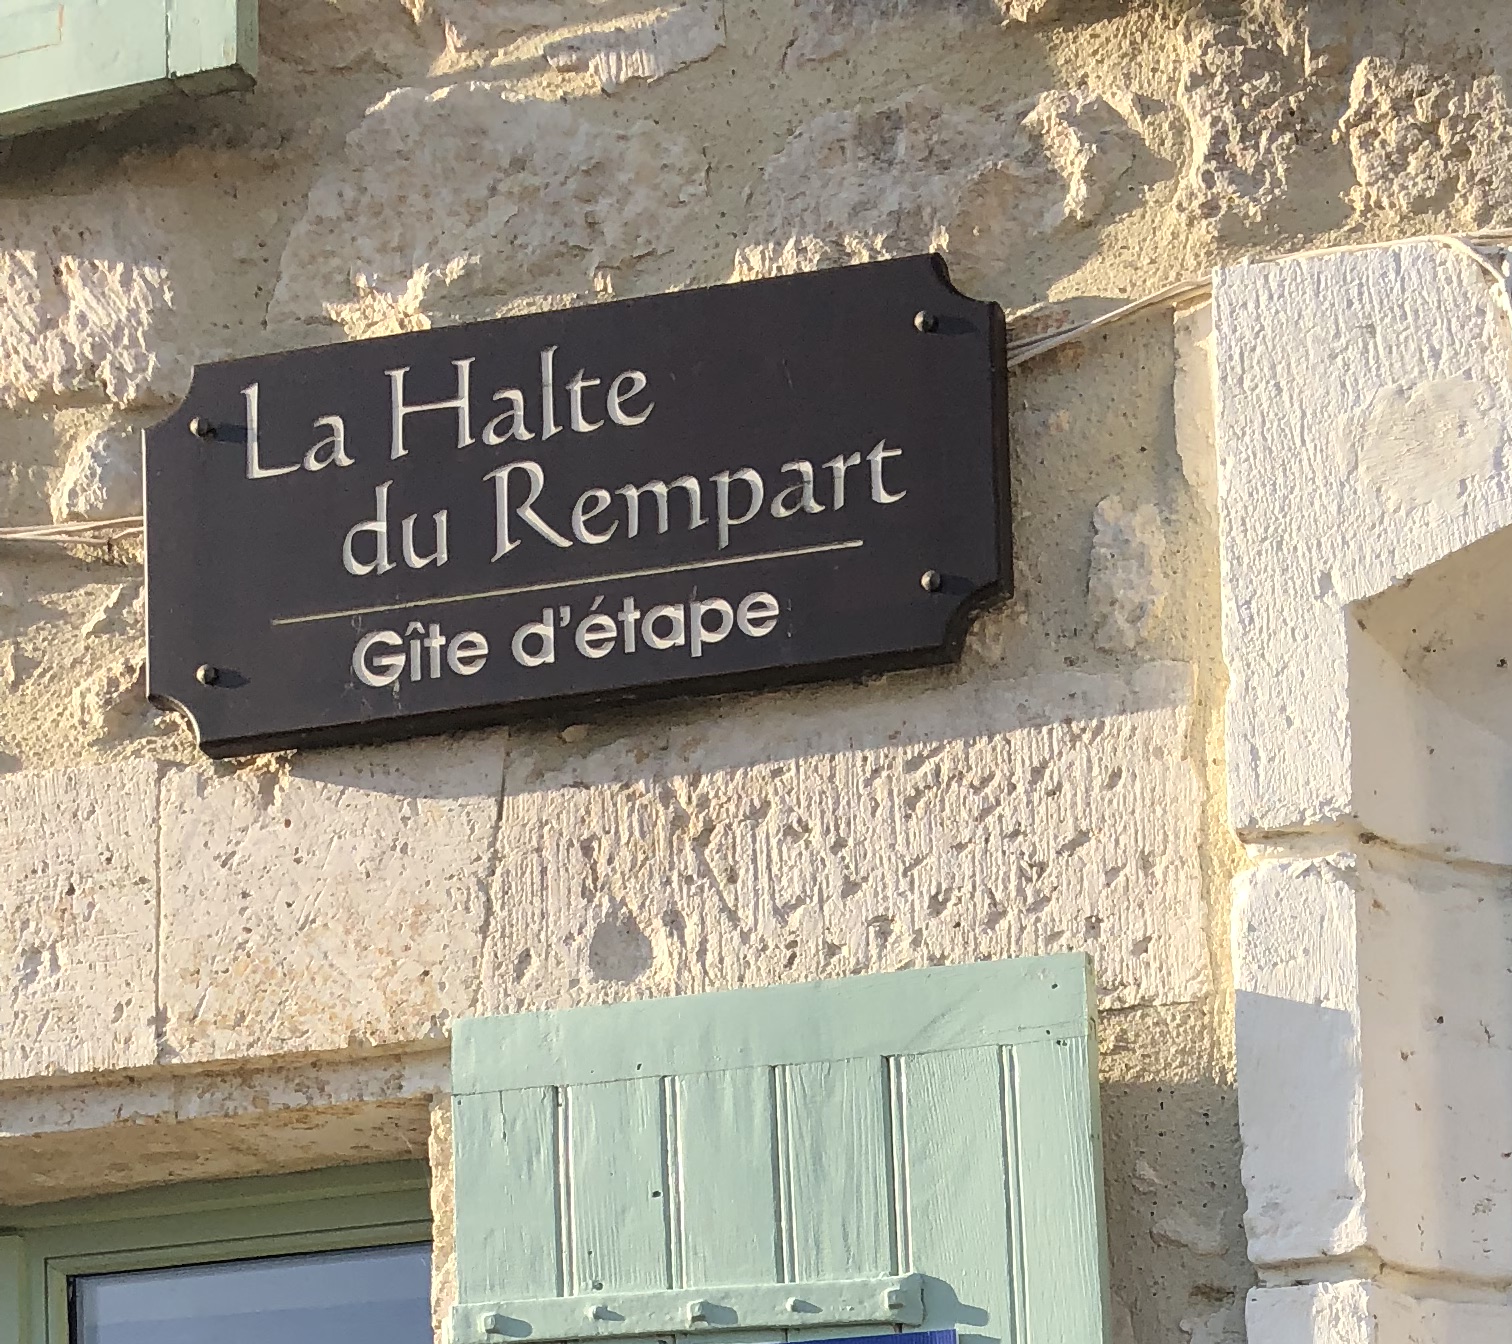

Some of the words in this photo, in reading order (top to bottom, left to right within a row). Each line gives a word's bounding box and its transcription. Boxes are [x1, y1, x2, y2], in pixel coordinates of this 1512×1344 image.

[241, 380, 355, 481] La
[385, 345, 655, 462] Halte
[341, 481, 449, 578] du
[483, 437, 908, 564] Rempart
[352, 622, 489, 689] Gîte
[511, 590, 781, 669] d'étape
